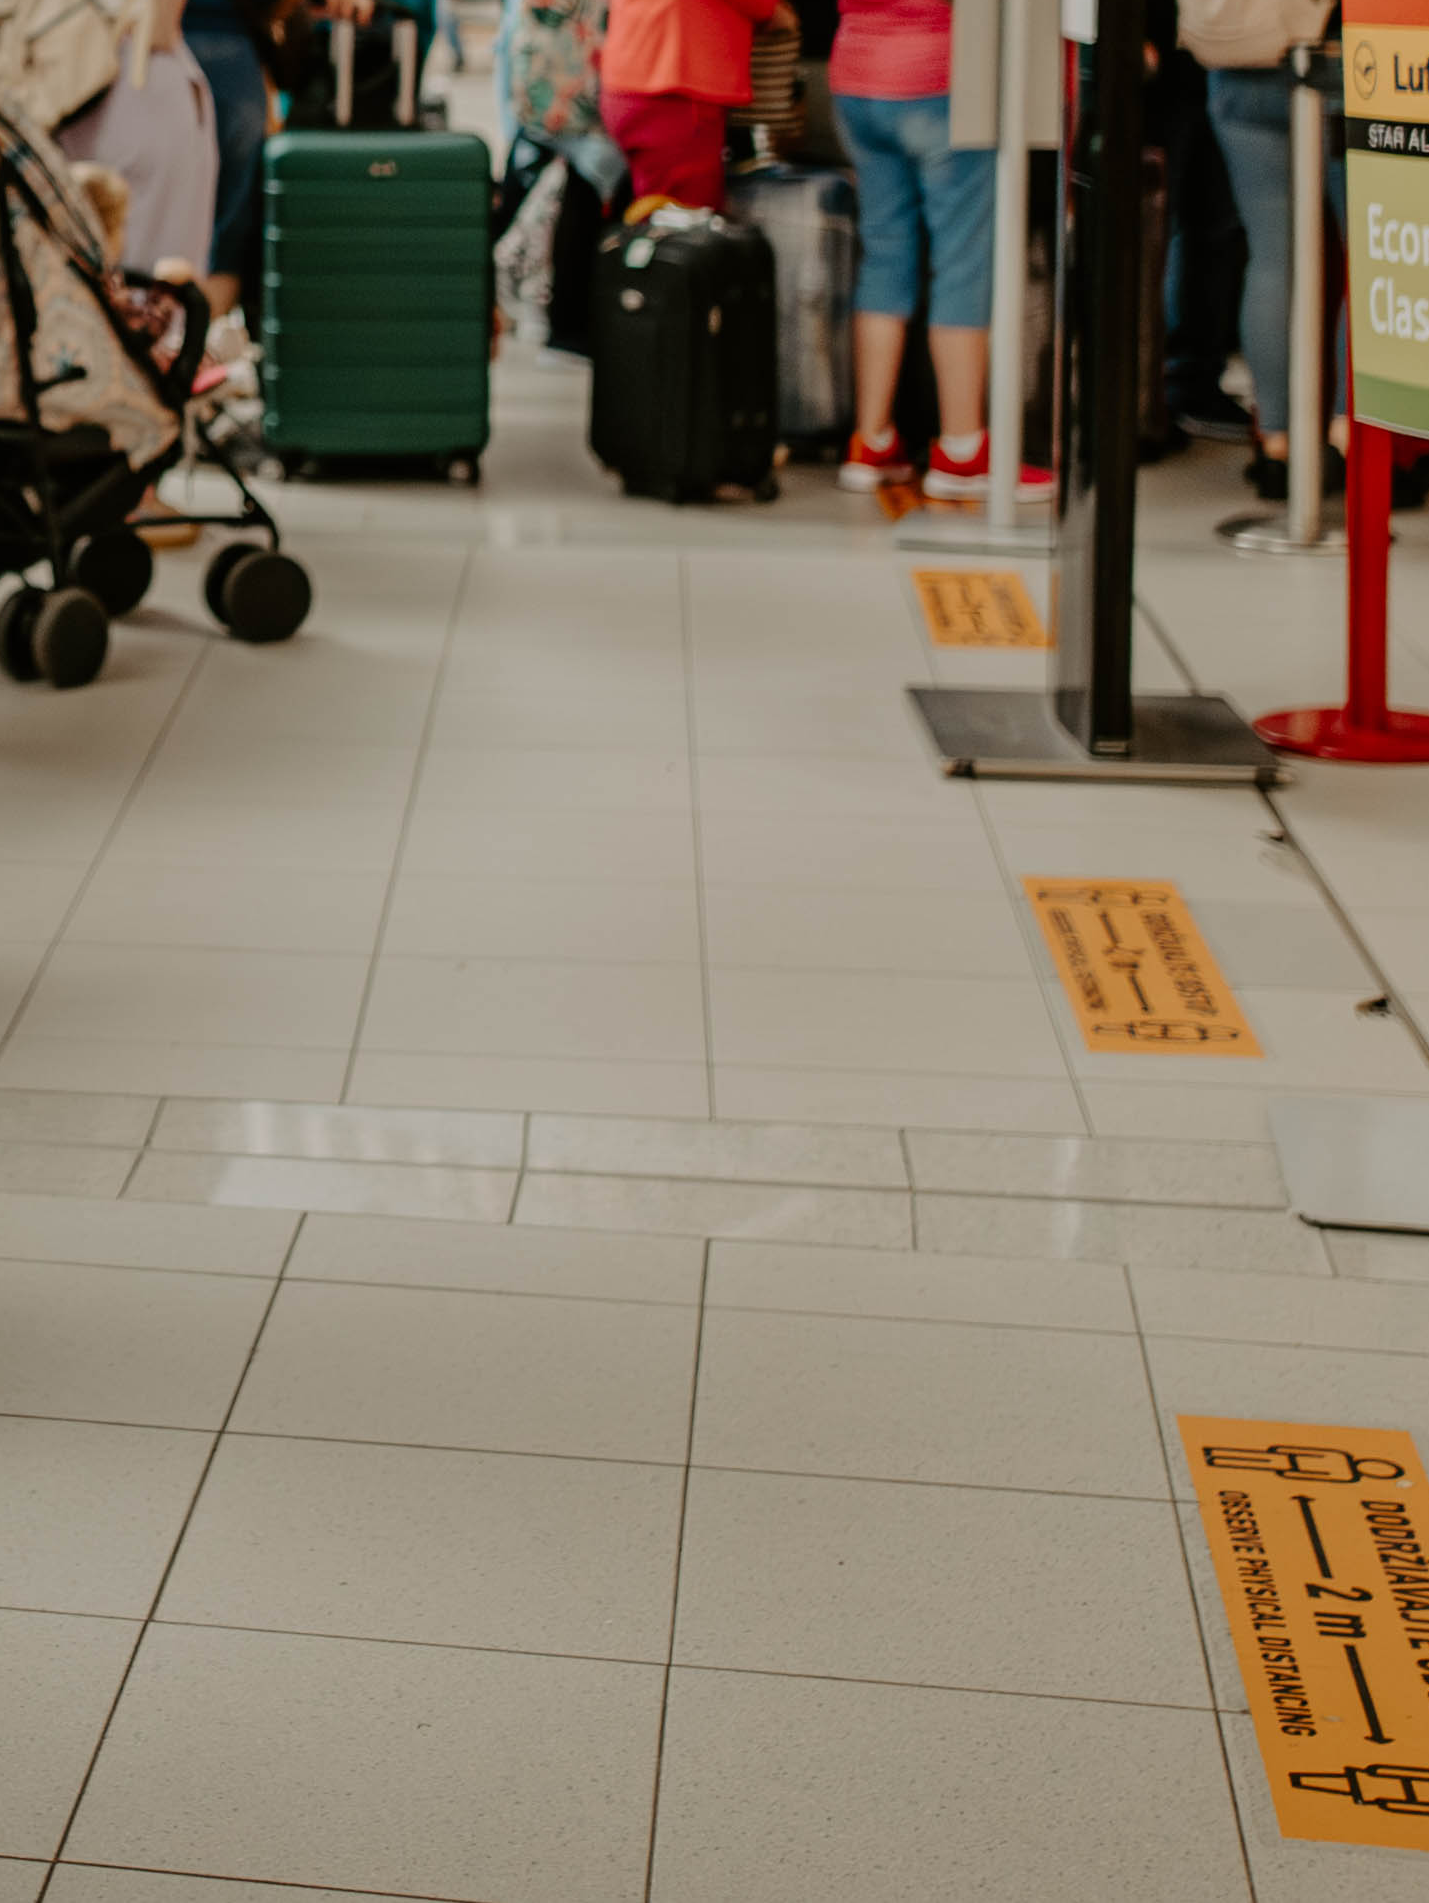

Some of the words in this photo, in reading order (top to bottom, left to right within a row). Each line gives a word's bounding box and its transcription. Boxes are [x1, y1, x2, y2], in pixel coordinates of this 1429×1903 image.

[1368, 123, 1405, 149] STAR
[1239, 1557, 1287, 1631] PHYSICAL
[1305, 1582, 1374, 1603] 2
[1257, 1635, 1317, 1737] DISTANCING
